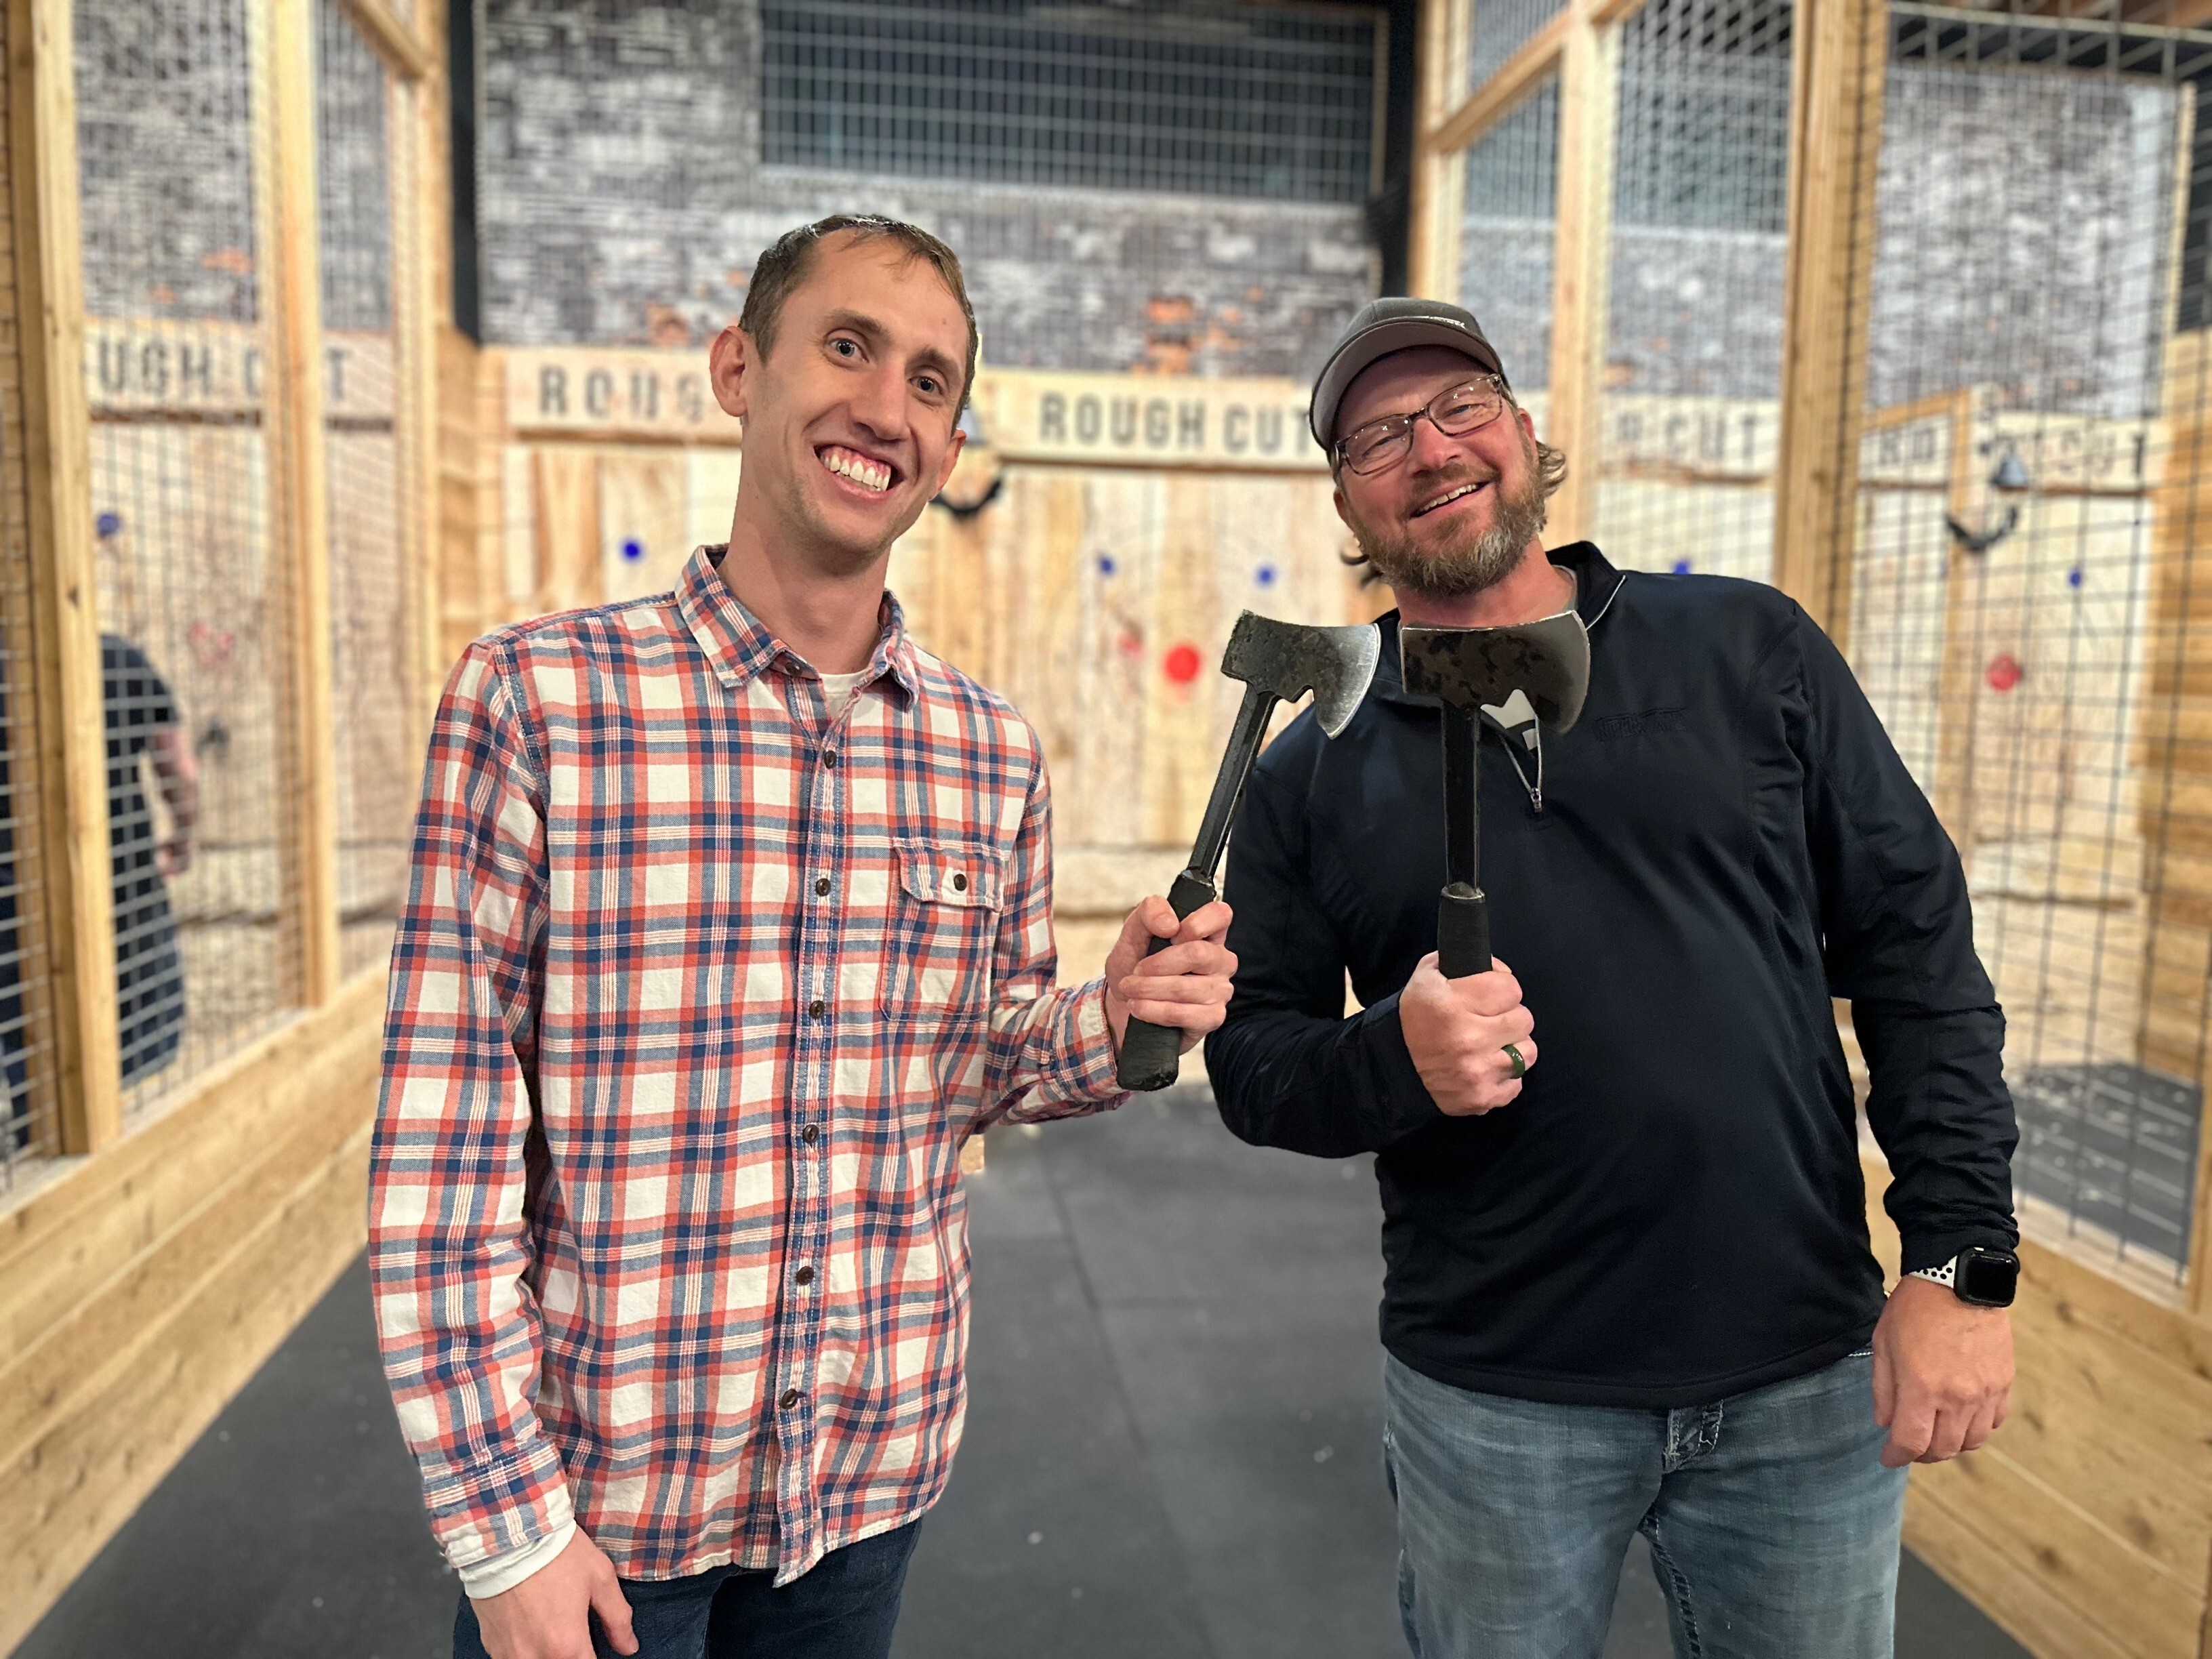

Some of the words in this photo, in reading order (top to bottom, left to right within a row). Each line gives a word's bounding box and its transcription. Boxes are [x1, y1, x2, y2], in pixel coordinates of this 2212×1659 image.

[83, 337, 212, 396] UGH
[538, 364, 704, 424] ROUG
[1040, 391, 1206, 450] ROUGH
[1223, 408, 1313, 457] CUT
